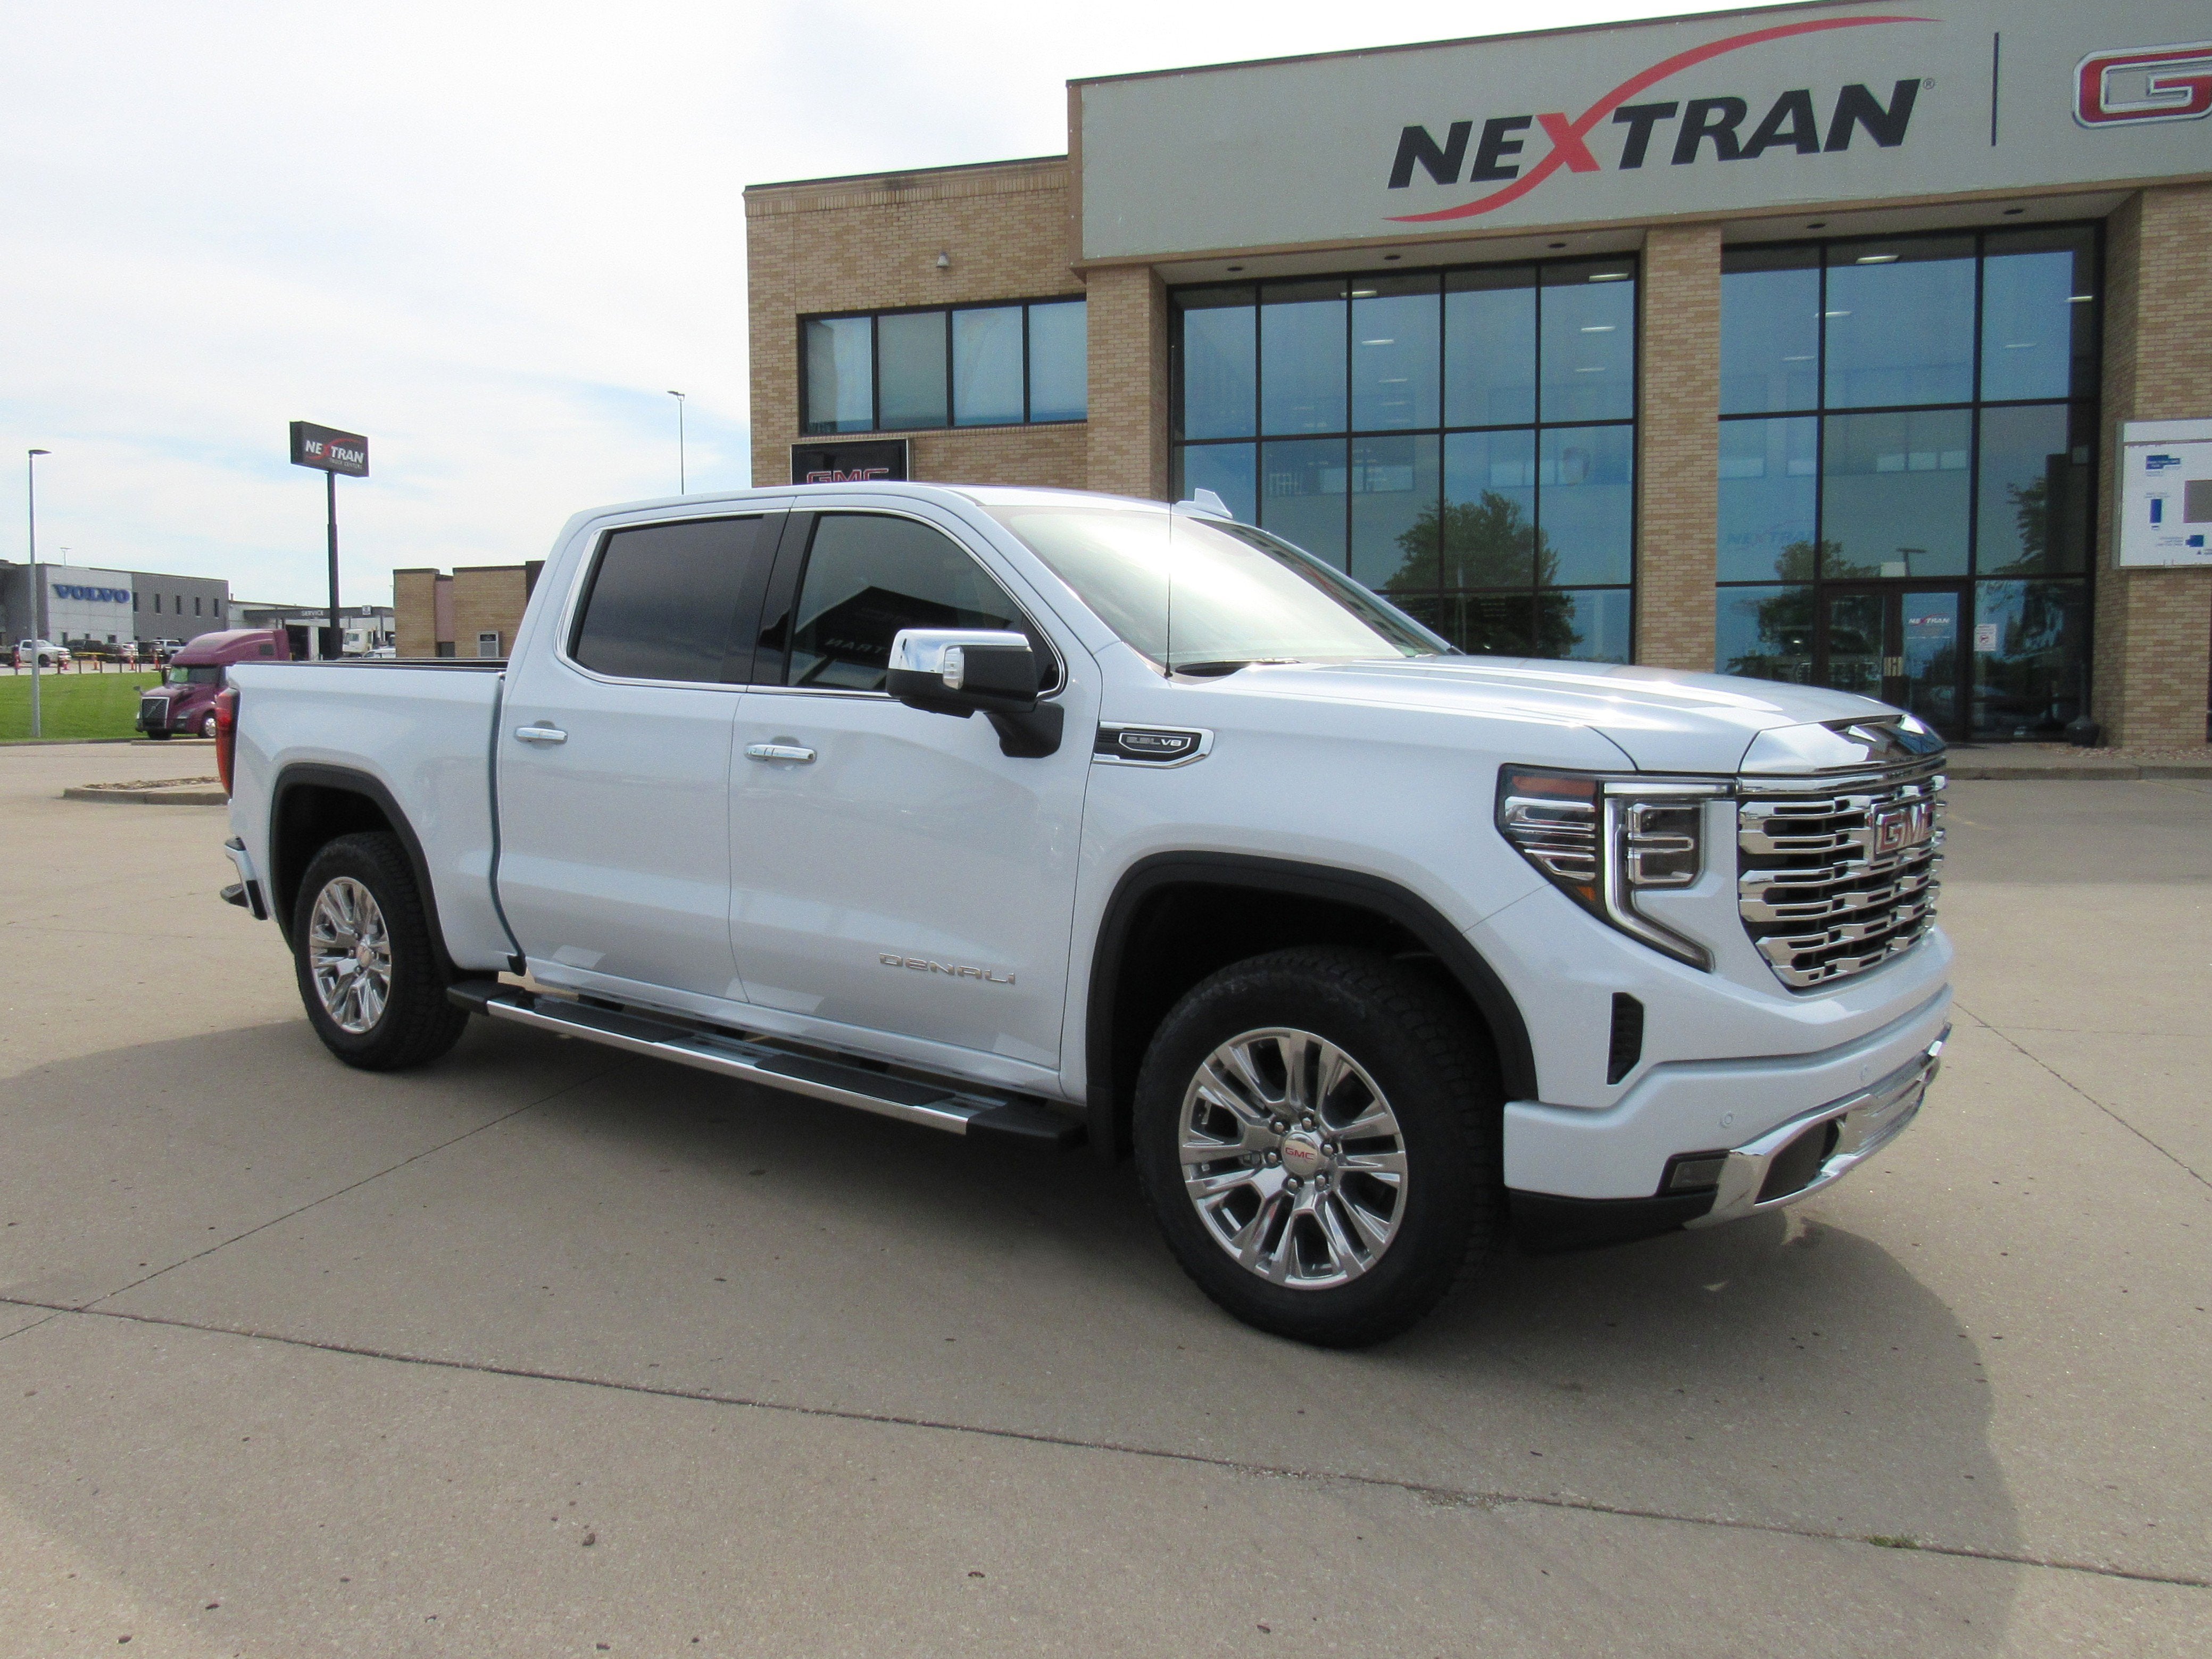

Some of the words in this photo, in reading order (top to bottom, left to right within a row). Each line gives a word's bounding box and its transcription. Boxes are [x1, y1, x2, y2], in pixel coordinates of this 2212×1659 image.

[1387, 78, 1921, 189] NEXTRAN
[305, 439, 364, 465] NEXTRAN
[806, 468, 889, 484] GMC
[52, 584, 131, 603] VOLVO
[1161, 738, 1182, 746] V8
[879, 952, 1016, 985] DENALI
[1285, 1147, 1315, 1160] GMC
